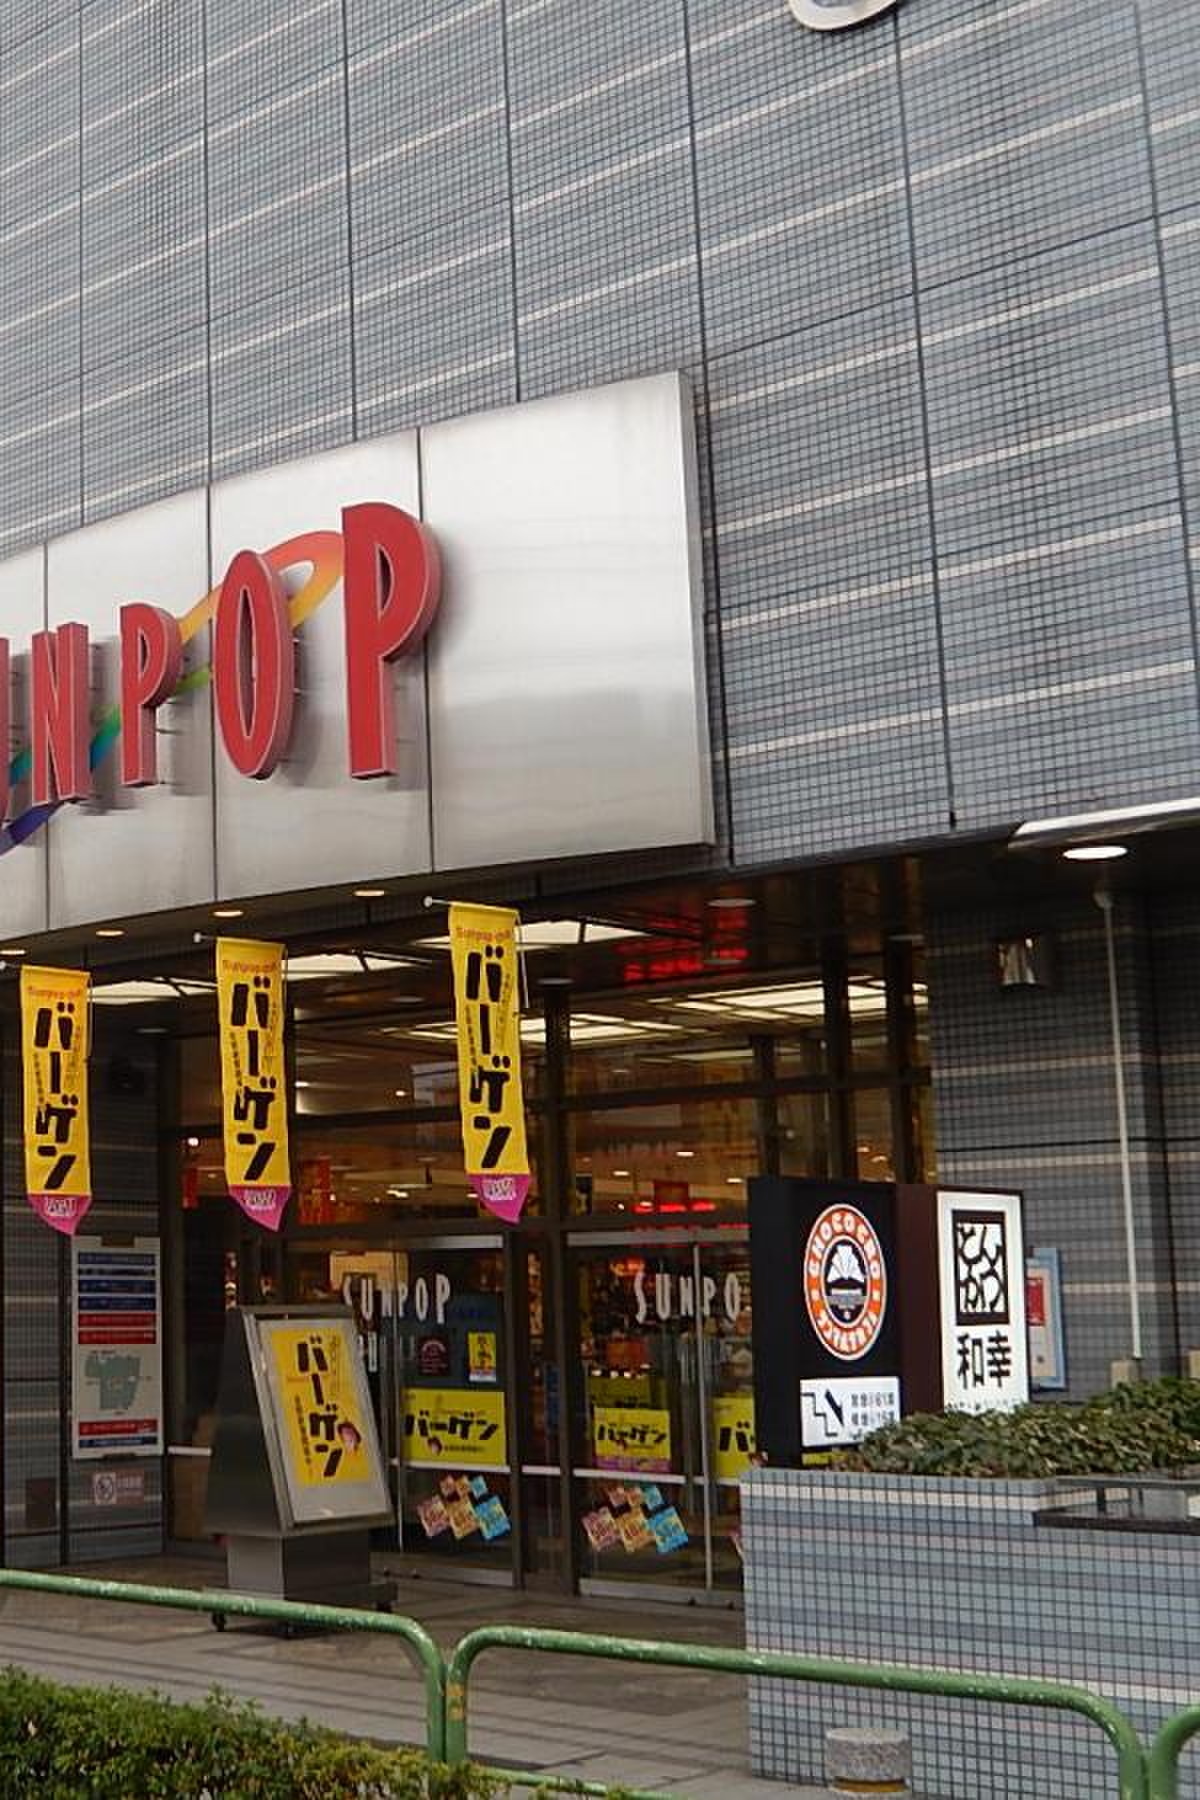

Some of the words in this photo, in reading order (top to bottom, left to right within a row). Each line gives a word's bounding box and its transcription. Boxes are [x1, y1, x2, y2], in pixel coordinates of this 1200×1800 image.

[33, 1001, 79, 1190] バーゲン
[231, 976, 277, 1181] バーゲン
[465, 945, 512, 1170] バーゲン
[297, 1335, 343, 1478] バーゲン
[404, 1409, 499, 1441] バーゲン
[957, 1330, 1012, 1390] 和幸
[719, 1421, 754, 1452] バ
